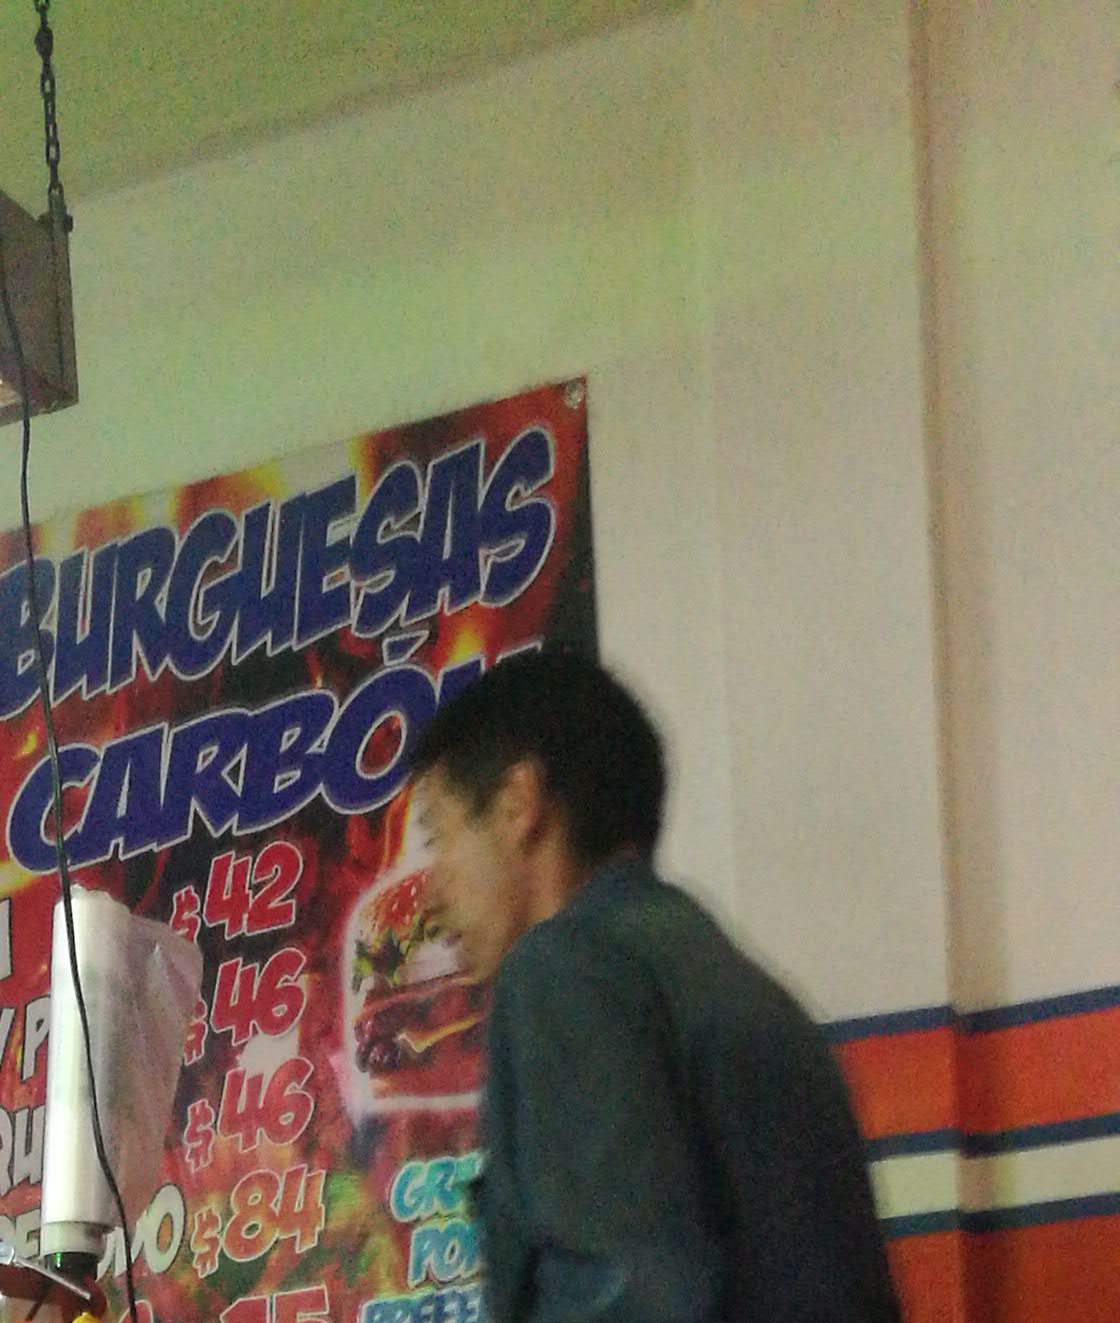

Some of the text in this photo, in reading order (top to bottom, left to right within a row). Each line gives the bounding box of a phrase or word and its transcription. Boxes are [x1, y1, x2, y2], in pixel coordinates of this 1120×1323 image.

[6, 630, 544, 876] CARBÓ
[183, 1055, 316, 1173] $46
[190, 1163, 327, 1280] $84
